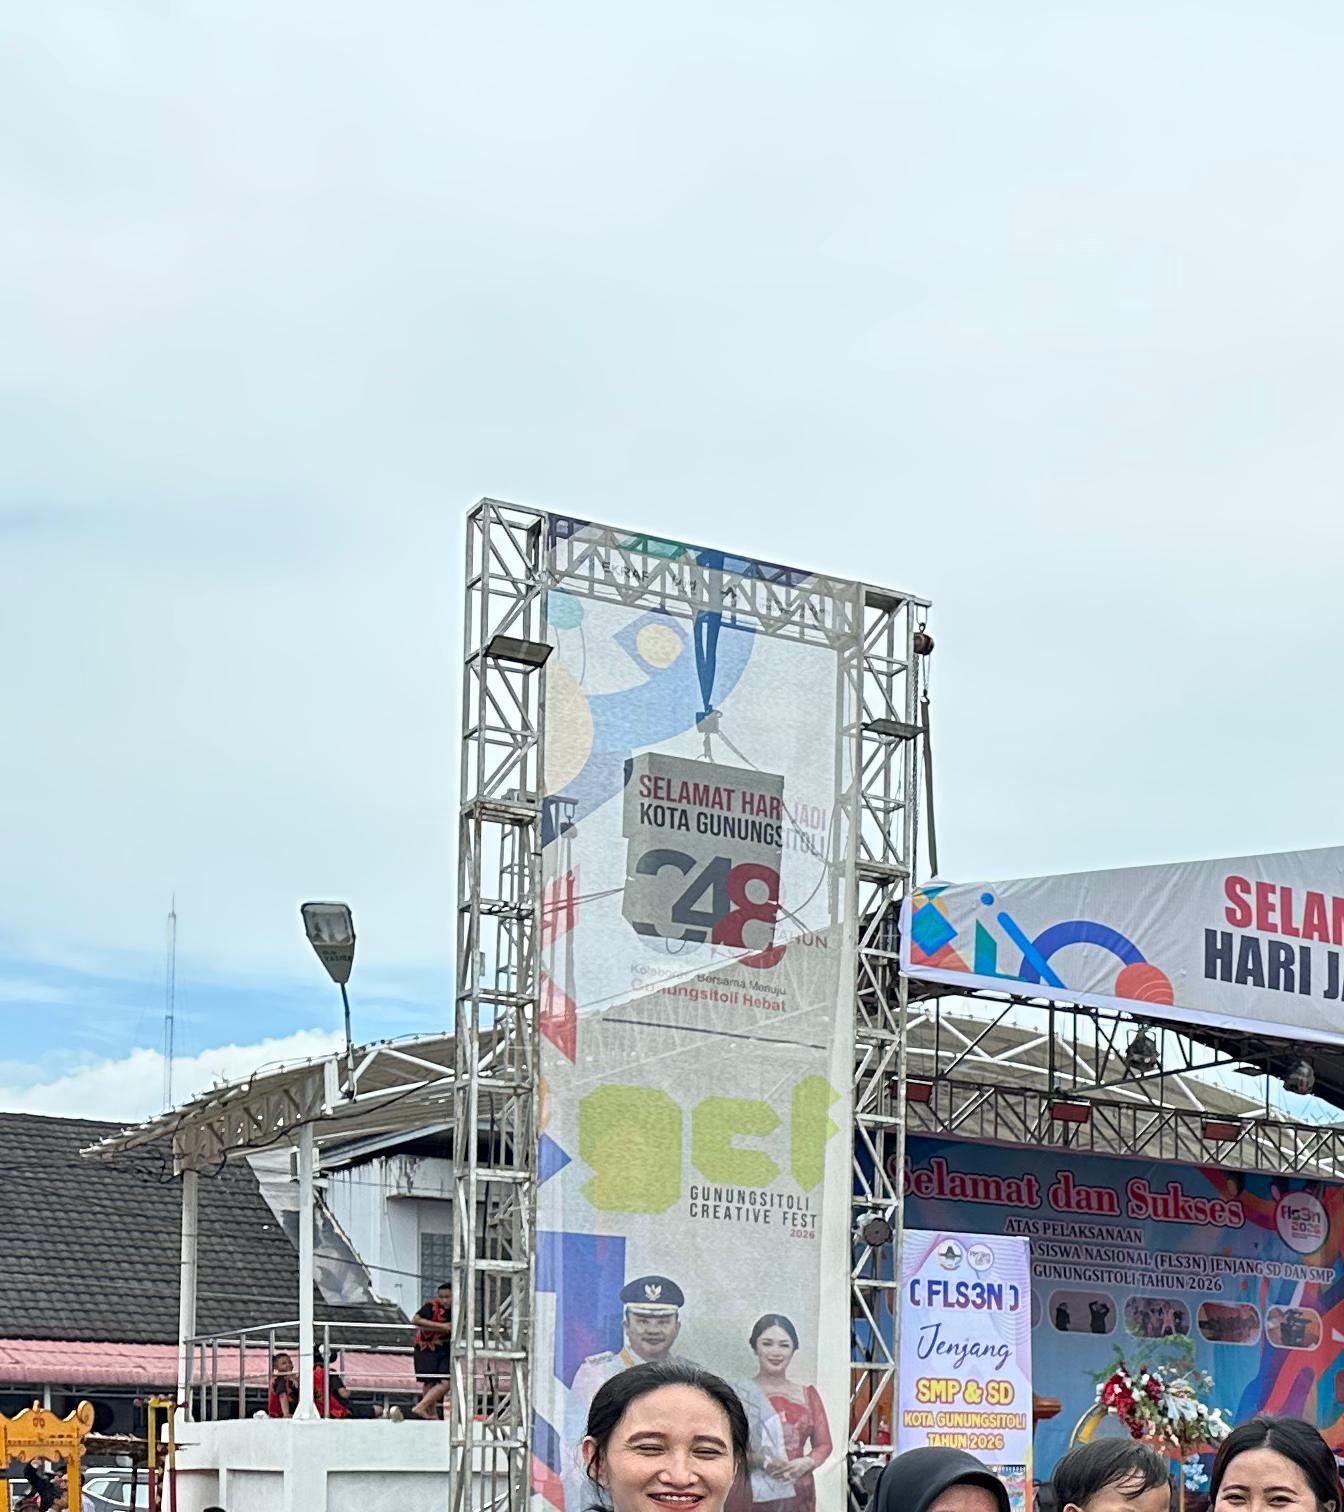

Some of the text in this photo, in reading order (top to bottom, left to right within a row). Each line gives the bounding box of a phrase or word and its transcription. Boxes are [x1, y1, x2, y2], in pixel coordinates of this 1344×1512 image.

[640, 774, 735, 812] SELAMAT
[640, 802, 690, 832] KOTA
[1204, 928, 1311, 996] HARI
[743, 995, 786, 1012] Hebat
[690, 1185, 809, 1211] GUNUNGSITOLI
[888, 1155, 1245, 1227] Selamat dan Sukses
[689, 1202, 817, 1229] CREATIVE FEST
[1006, 1218, 1142, 1244] ATAS PELAKSANAAN
[1039, 1246, 1082, 1260] SISWA
[1085, 1249, 1150, 1266] NASIONAL
[1155, 1254, 1207, 1274] (FLS3N)
[1210, 1259, 1263, 1278] JENJANG
[1265, 1263, 1281, 1276] SD
[1284, 1266, 1307, 1279] DAN
[1309, 1269, 1334, 1282] SMP
[1034, 1264, 1222, 1292] GUNUNGSITOLI TAHUN 2026
[917, 1322, 1012, 1371] Jenjang
[917, 1378, 1015, 1404] SMP & SD
[904, 1411, 1026, 1429] KOTA GUNUNGSITOLI
[928, 1434, 1004, 1449] TAHUN 2026
